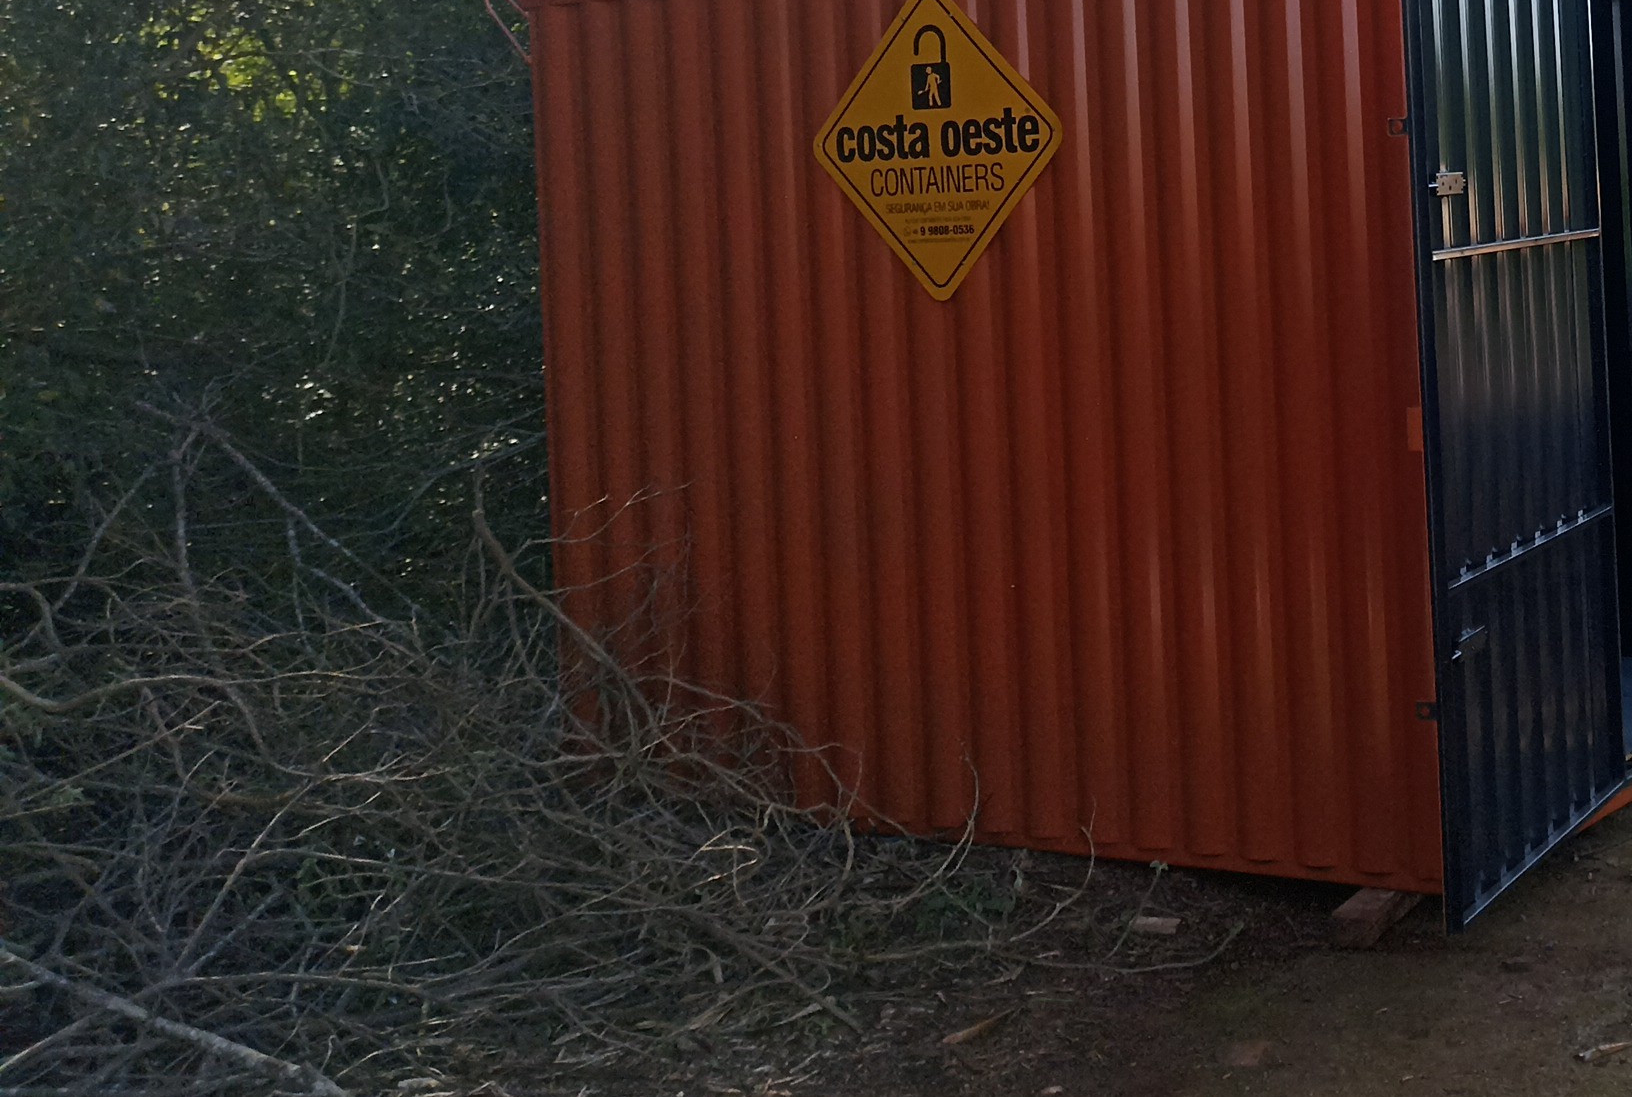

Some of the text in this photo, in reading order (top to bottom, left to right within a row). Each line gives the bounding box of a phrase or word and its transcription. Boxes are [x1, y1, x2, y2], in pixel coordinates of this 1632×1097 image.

[836, 107, 1040, 163] costa oeste
[870, 162, 1005, 198] CONTAINERS
[885, 202, 932, 215] SEGURANÇA
[933, 201, 946, 213] EM
[947, 200, 964, 212] SUA
